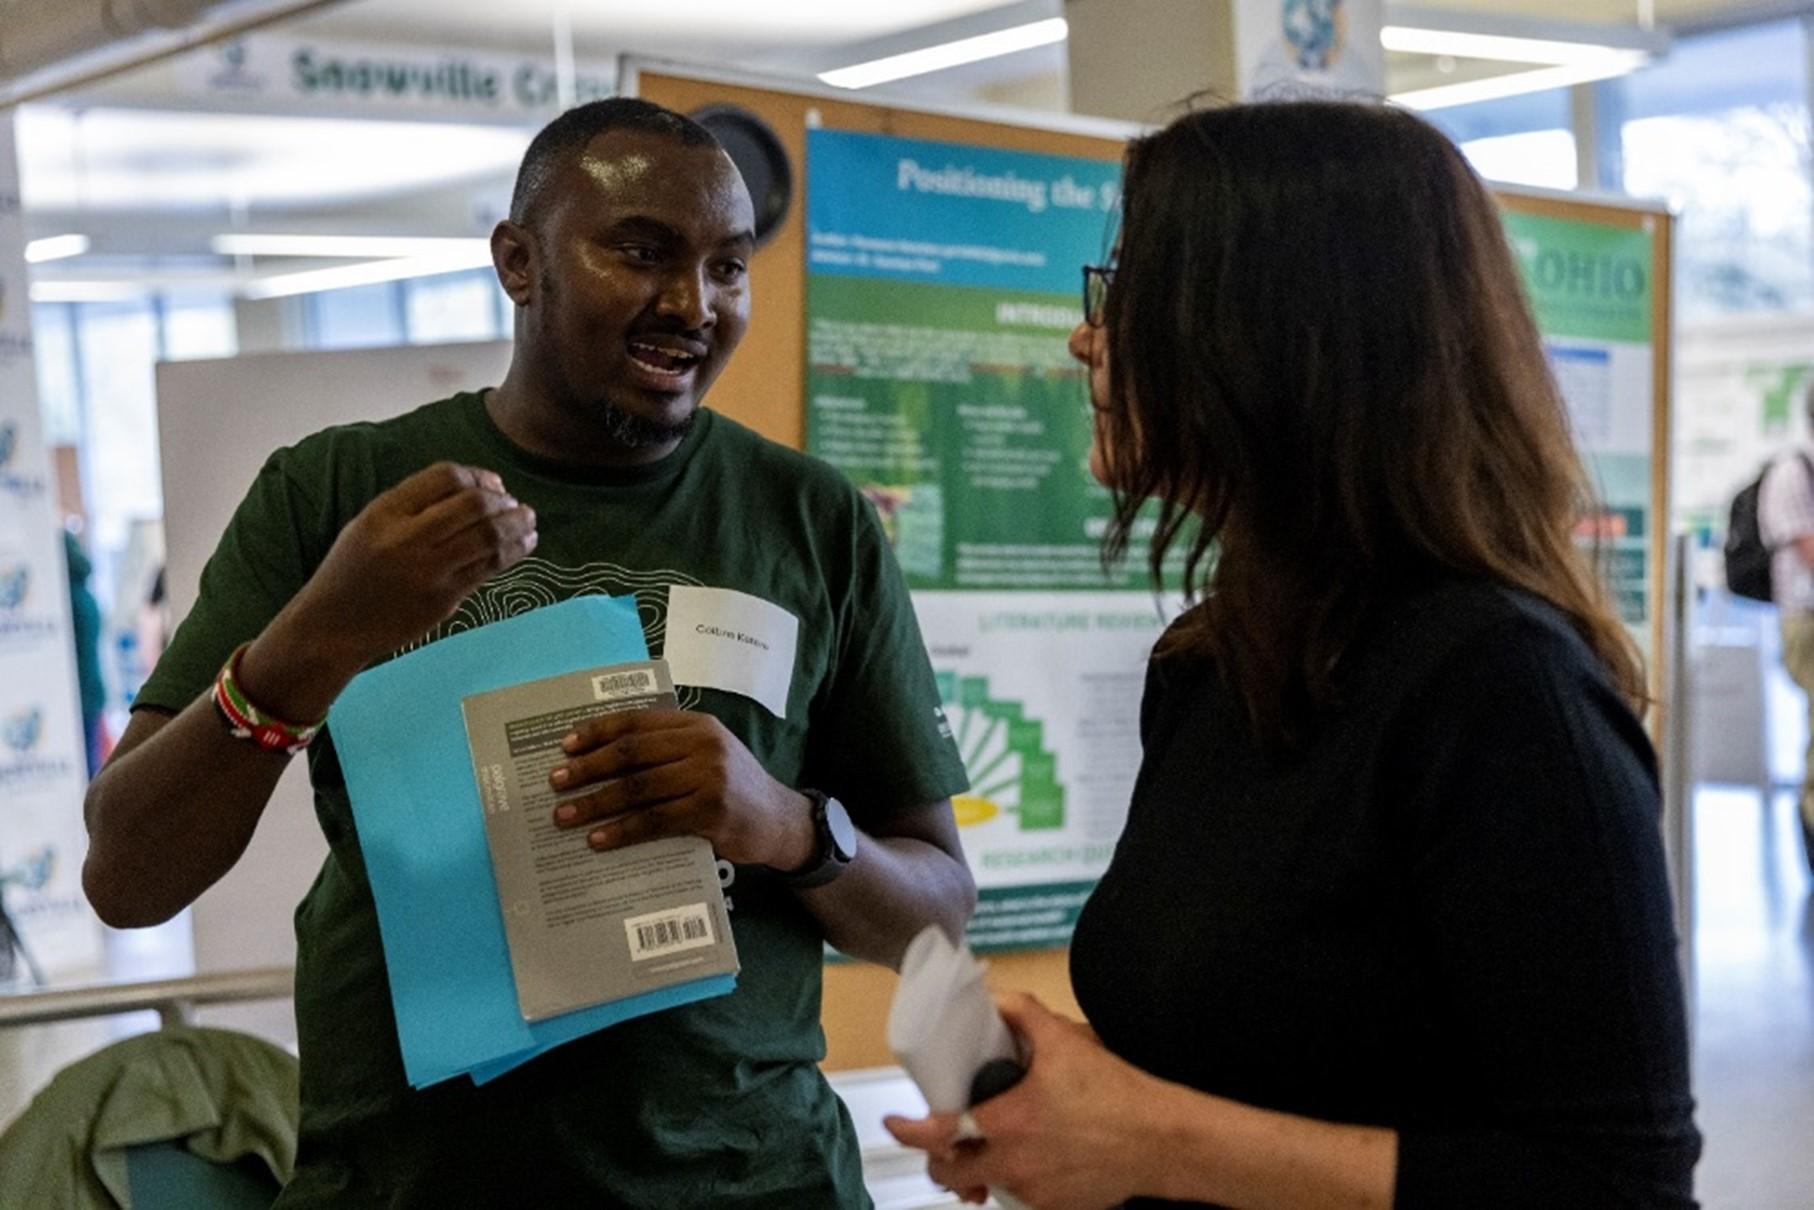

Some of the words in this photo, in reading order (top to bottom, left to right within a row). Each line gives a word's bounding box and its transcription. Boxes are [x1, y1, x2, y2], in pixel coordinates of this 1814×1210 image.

[293, 48, 498, 99] Snowville
[897, 158, 1046, 213] Positioning
[1051, 175, 1095, 209] the
[1535, 248, 1646, 302] OHIO
